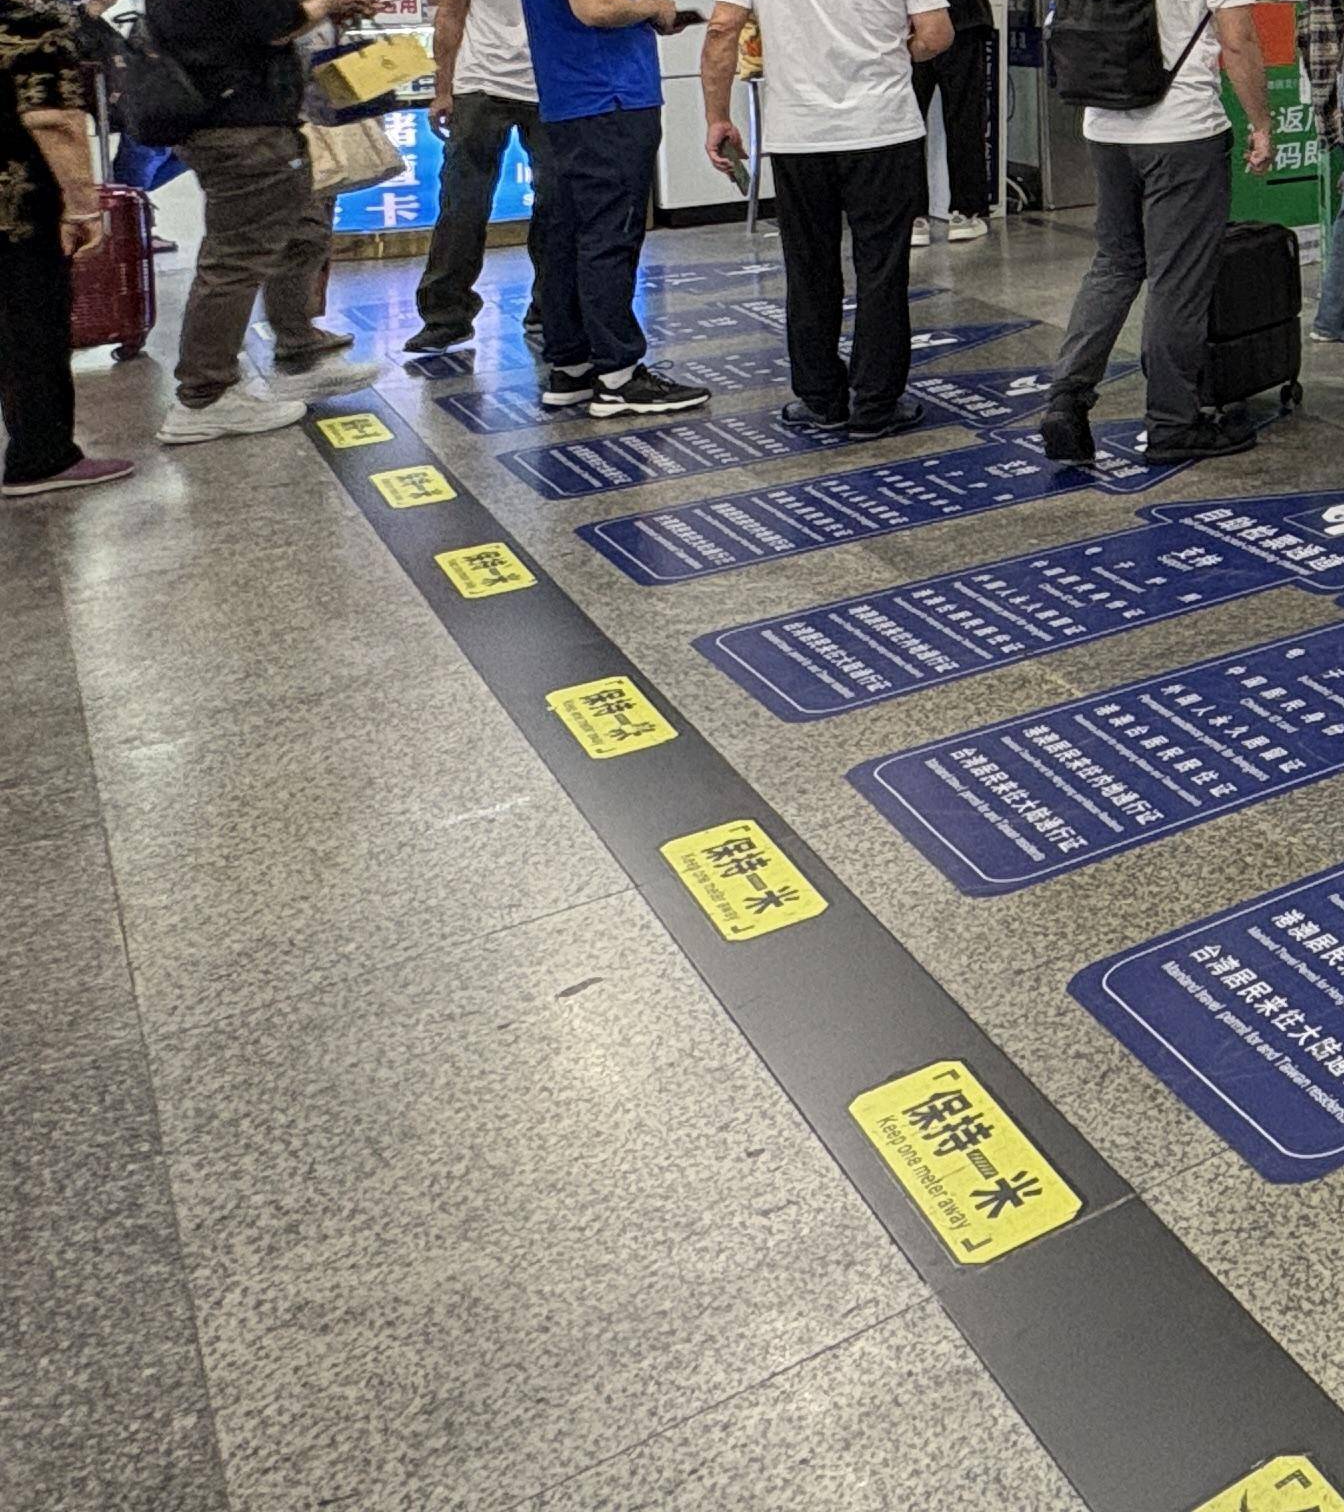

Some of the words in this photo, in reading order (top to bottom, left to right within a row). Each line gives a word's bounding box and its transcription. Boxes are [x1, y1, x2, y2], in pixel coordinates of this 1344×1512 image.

[876, 1114, 906, 1147] Keep
[899, 1144, 923, 1167] one
[913, 1161, 947, 1201] meter
[937, 1193, 971, 1231] away
[902, 1089, 1043, 1219] 保持一米
